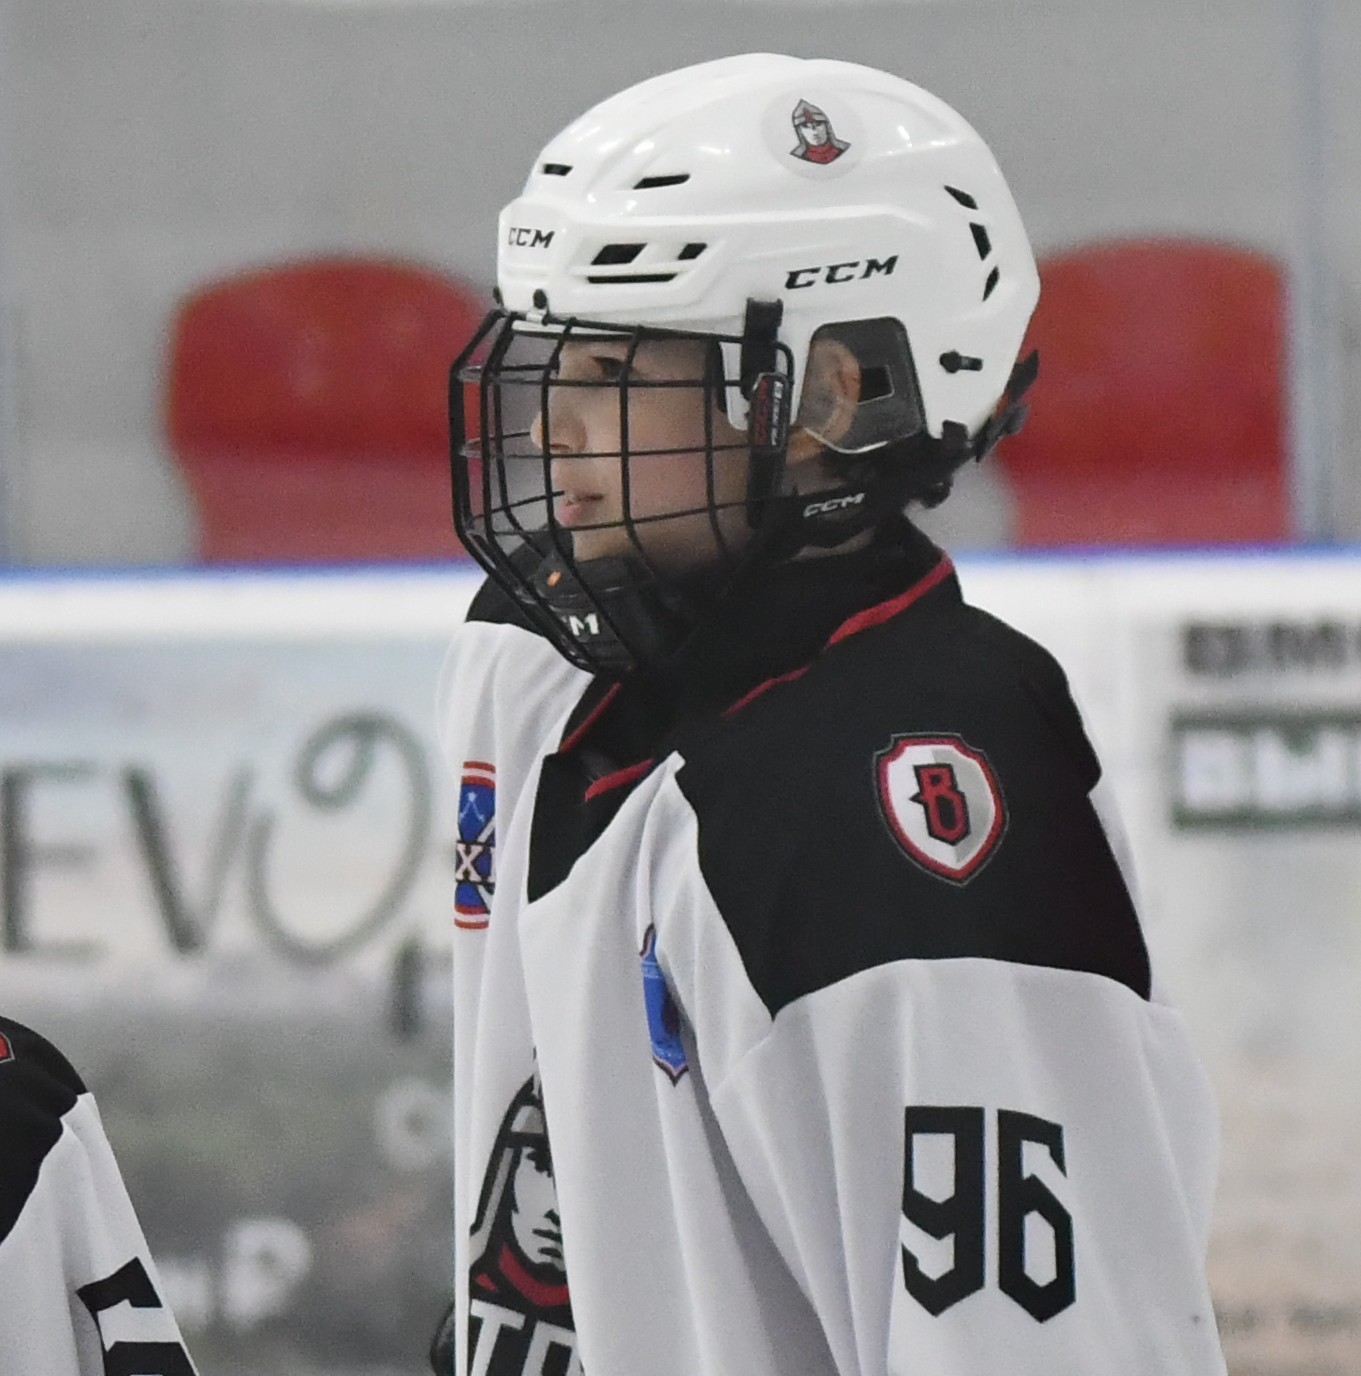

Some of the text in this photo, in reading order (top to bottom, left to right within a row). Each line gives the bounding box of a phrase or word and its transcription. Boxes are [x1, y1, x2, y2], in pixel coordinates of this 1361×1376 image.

[507, 226, 556, 249] CCM
[784, 254, 899, 290] CCM
[803, 492, 866, 518] CCM
[901, 1105, 1077, 1325] 96
